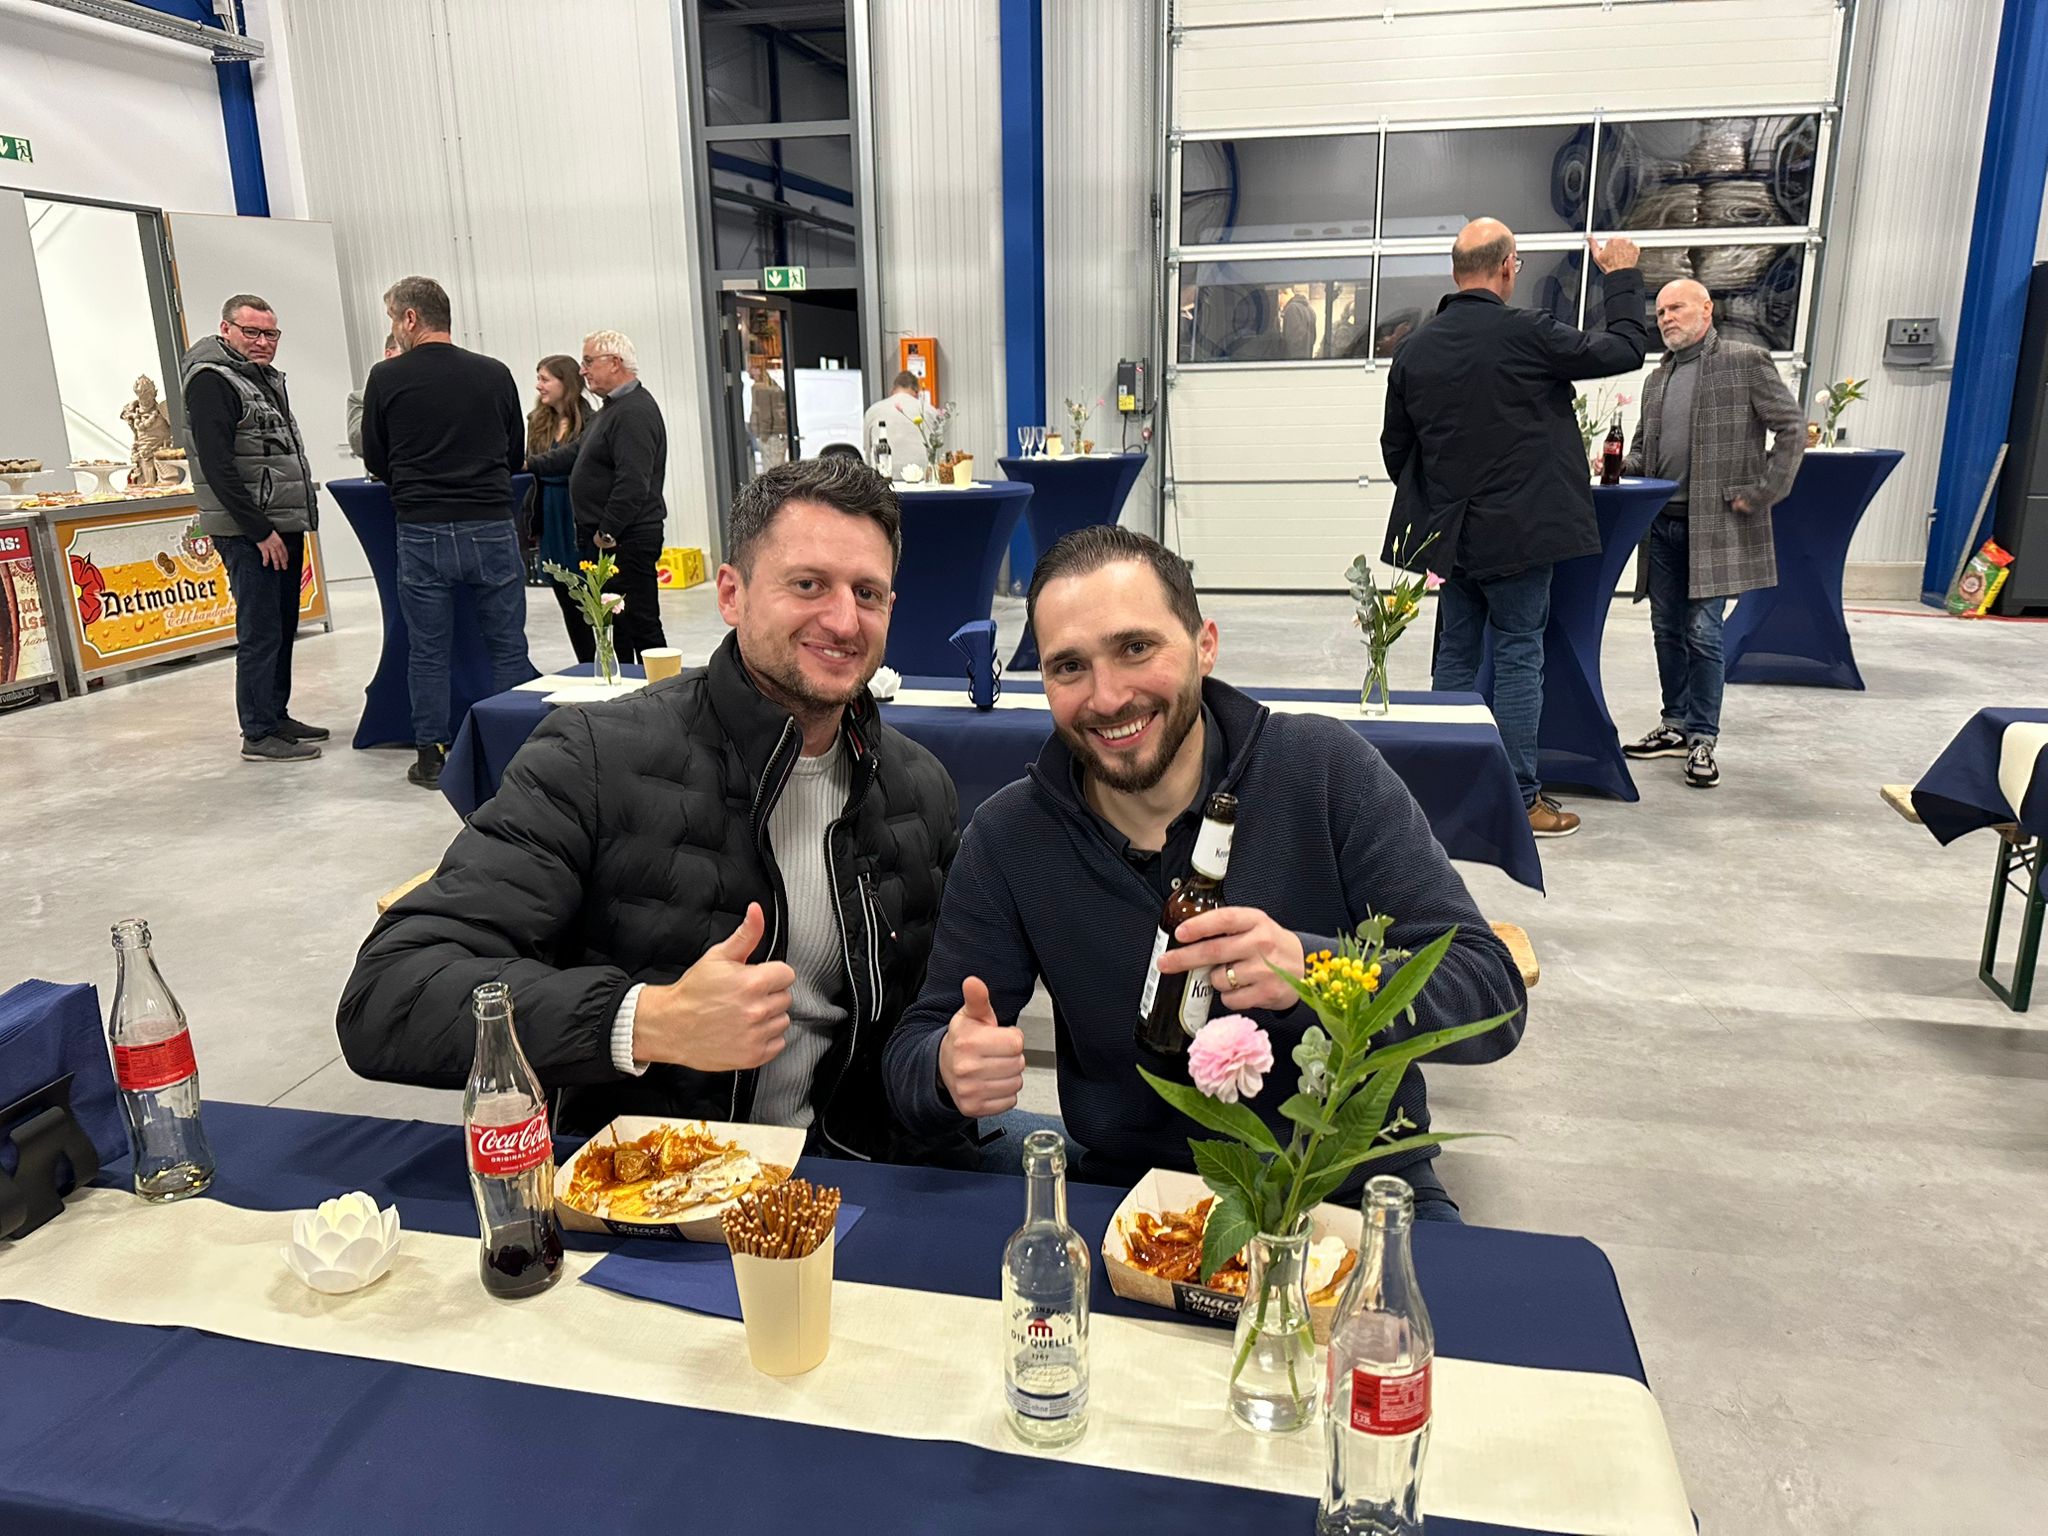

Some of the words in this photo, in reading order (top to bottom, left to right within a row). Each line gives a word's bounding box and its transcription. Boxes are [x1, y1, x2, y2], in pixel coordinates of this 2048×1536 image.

[100, 578, 217, 619] Detmolder
[478, 1110, 550, 1156] Coca-Cola
[490, 1153, 526, 1163] ORIGINAL
[529, 1143, 545, 1156] TASTE
[617, 1224, 671, 1236] Snack
[1011, 1329, 1026, 1344] DIE
[1030, 1334, 1073, 1349] QUELLE
